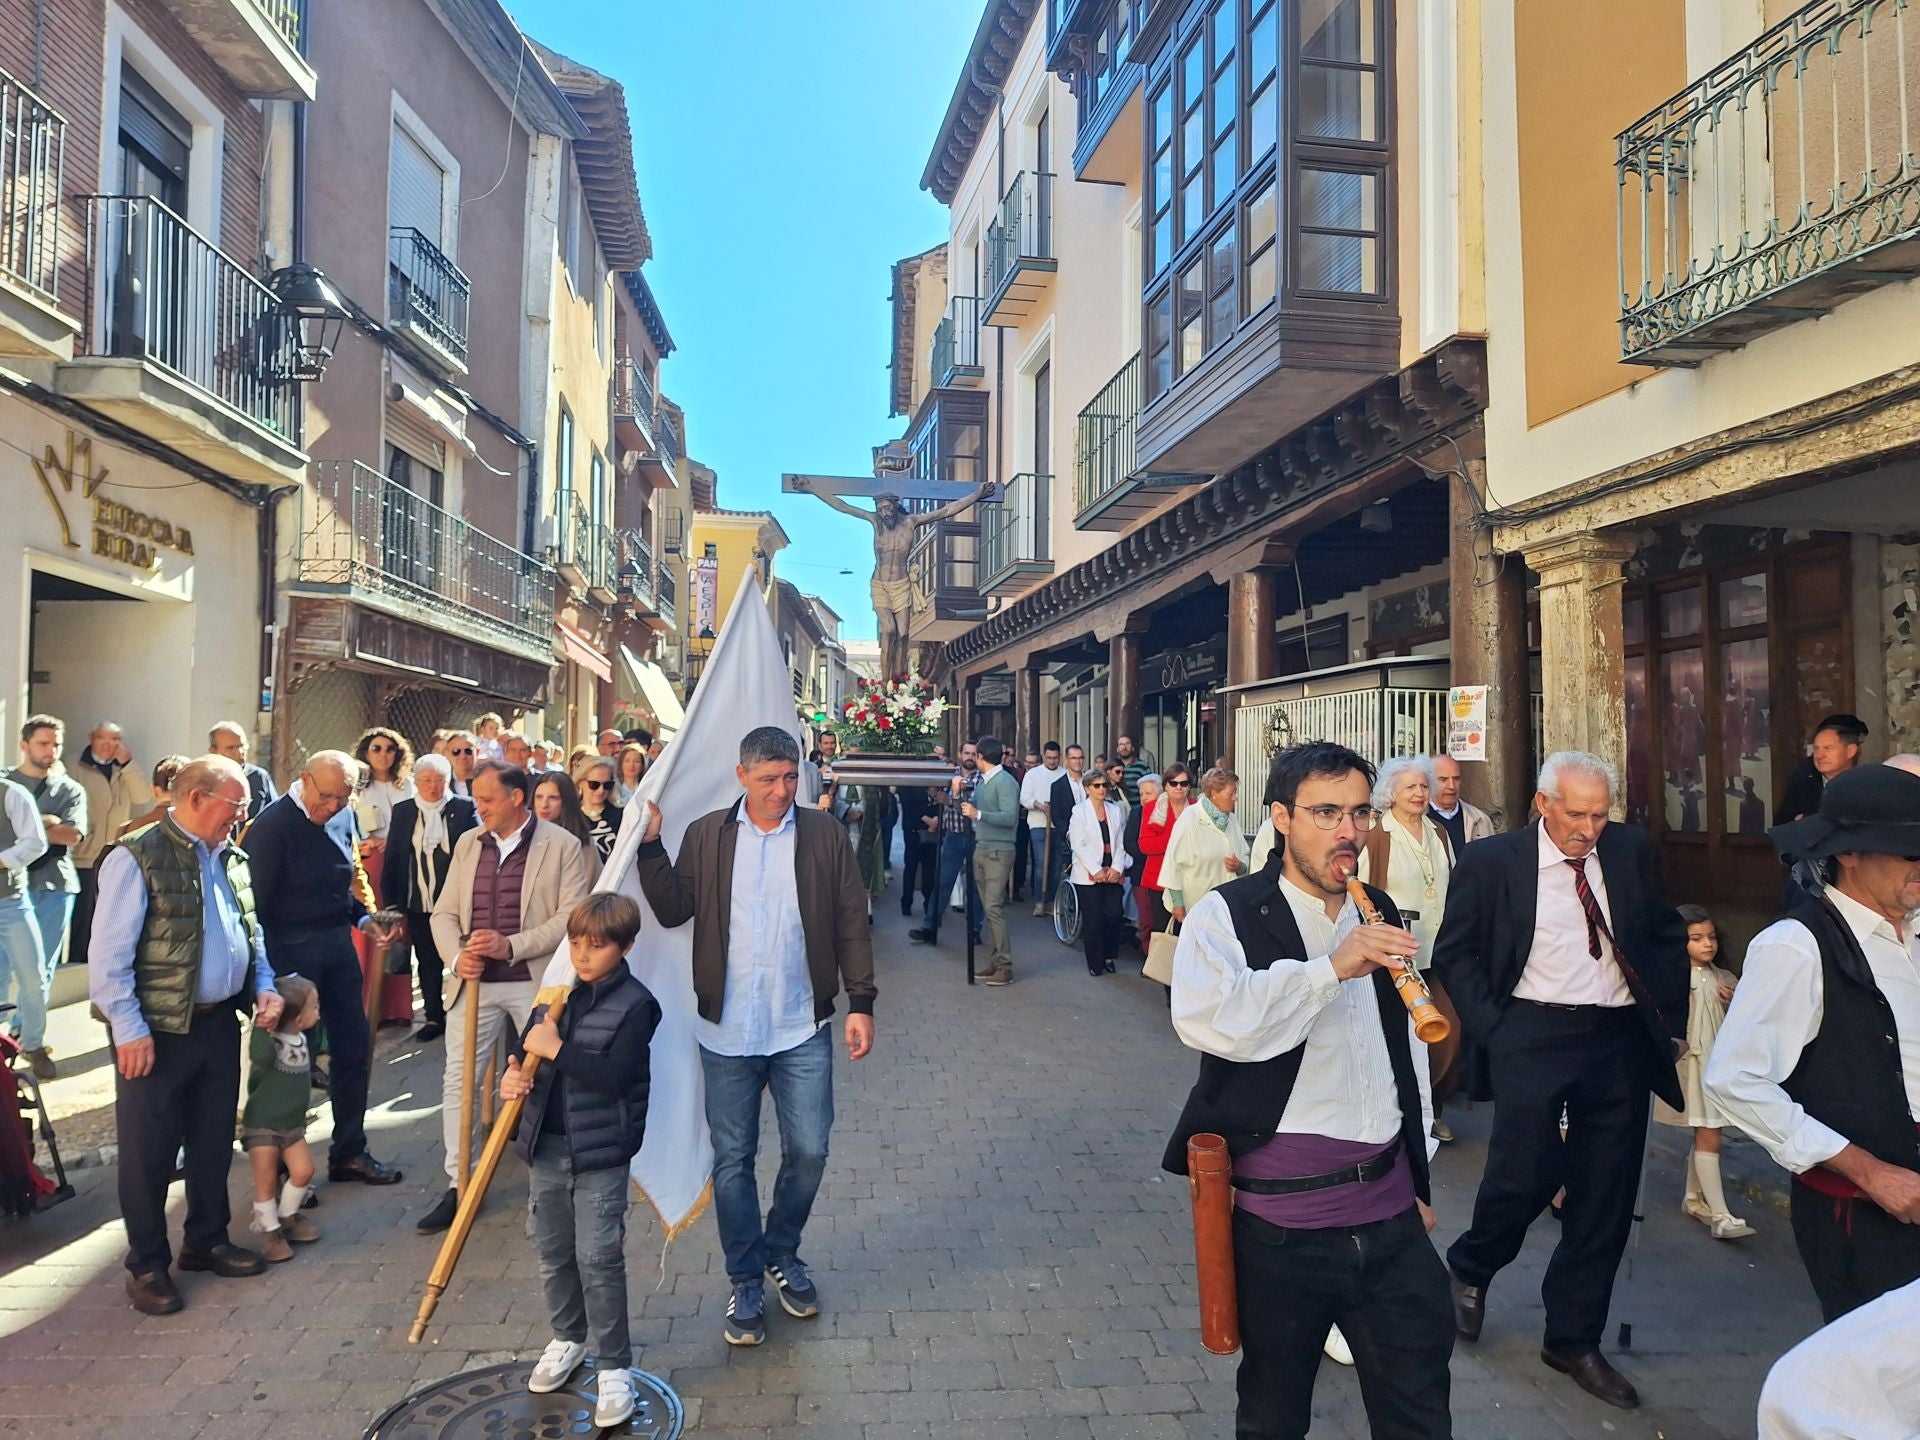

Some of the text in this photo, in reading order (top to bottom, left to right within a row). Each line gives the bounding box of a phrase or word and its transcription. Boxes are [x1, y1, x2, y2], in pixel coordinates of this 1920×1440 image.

[92, 527, 162, 574] RURAL
[698, 559, 717, 568] PAN
[700, 586, 713, 628] ESPIG
